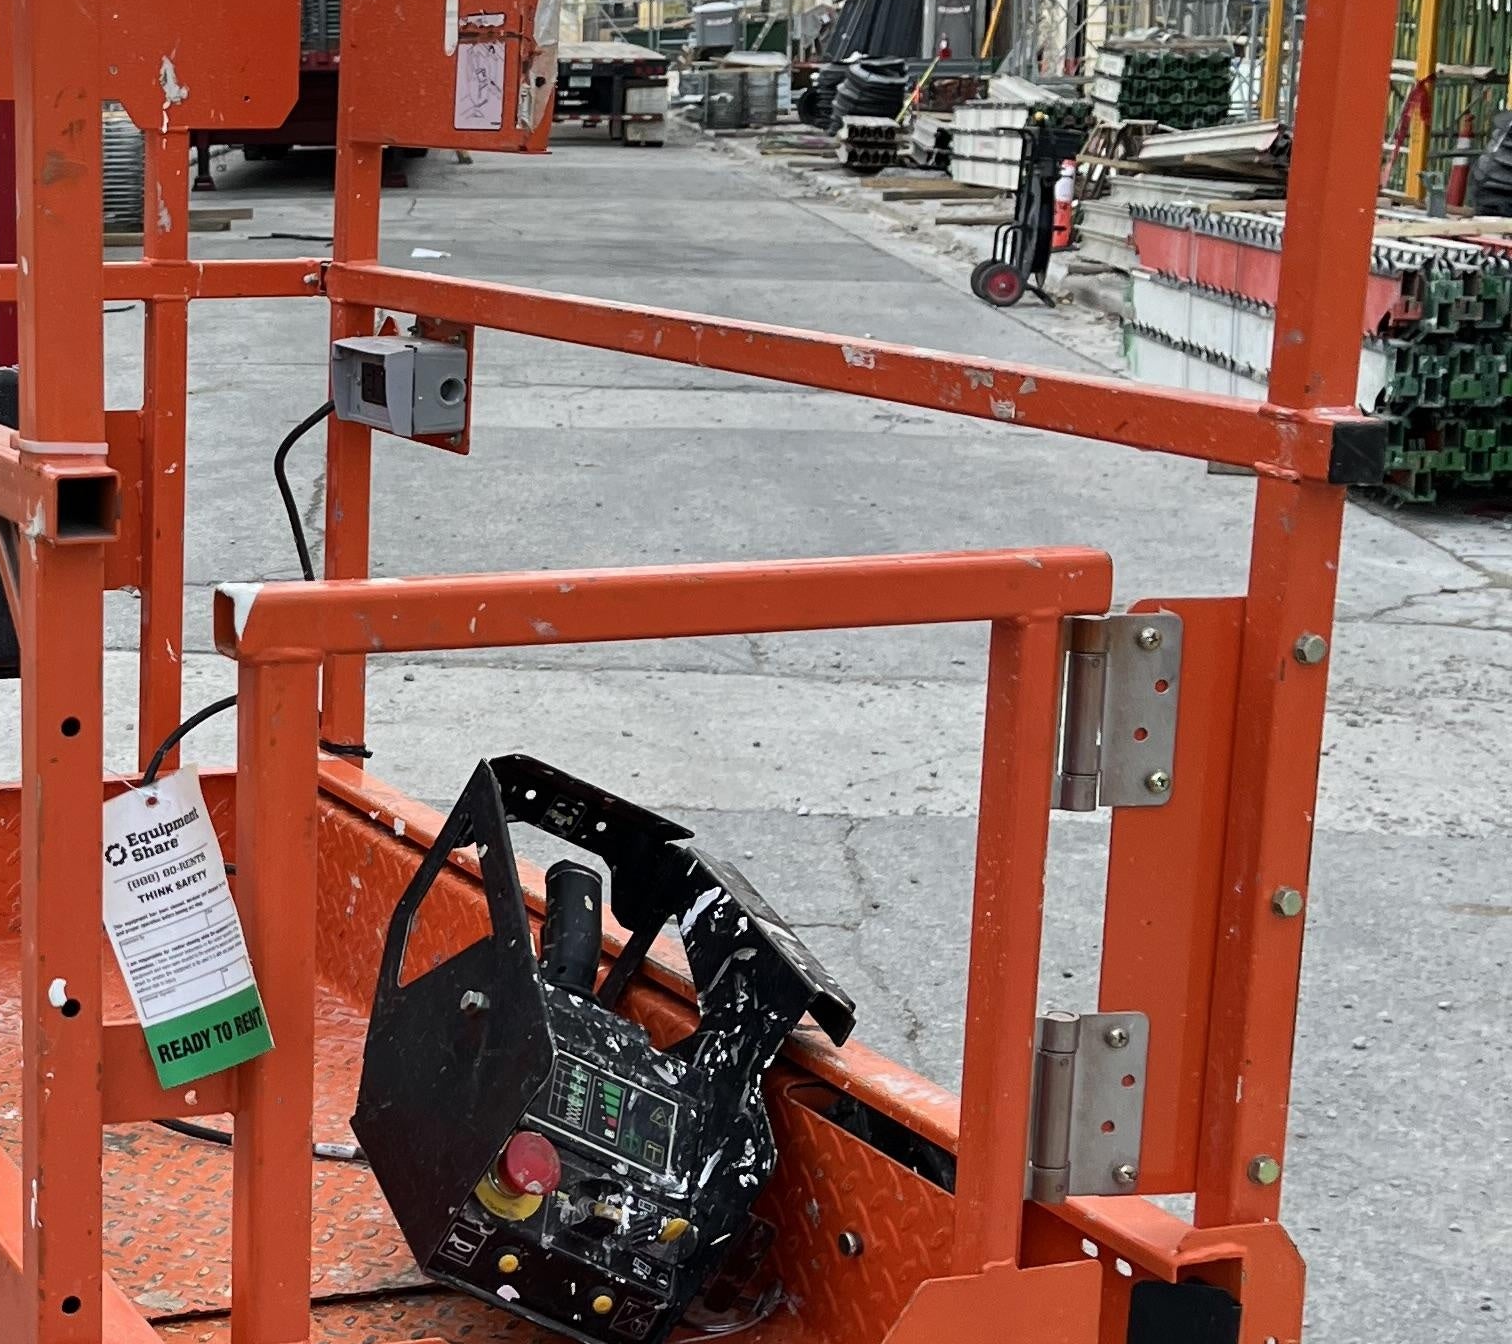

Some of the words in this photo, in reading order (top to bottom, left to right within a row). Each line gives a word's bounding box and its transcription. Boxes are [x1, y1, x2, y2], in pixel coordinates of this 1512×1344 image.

[126, 806, 200, 847] Equipment
[132, 837, 179, 863] Share
[137, 884, 174, 904] THINK
[175, 868, 208, 890] SAFETY
[157, 1031, 212, 1064] READY
[212, 1022, 234, 1044] TO
[235, 1007, 266, 1036] RENT
